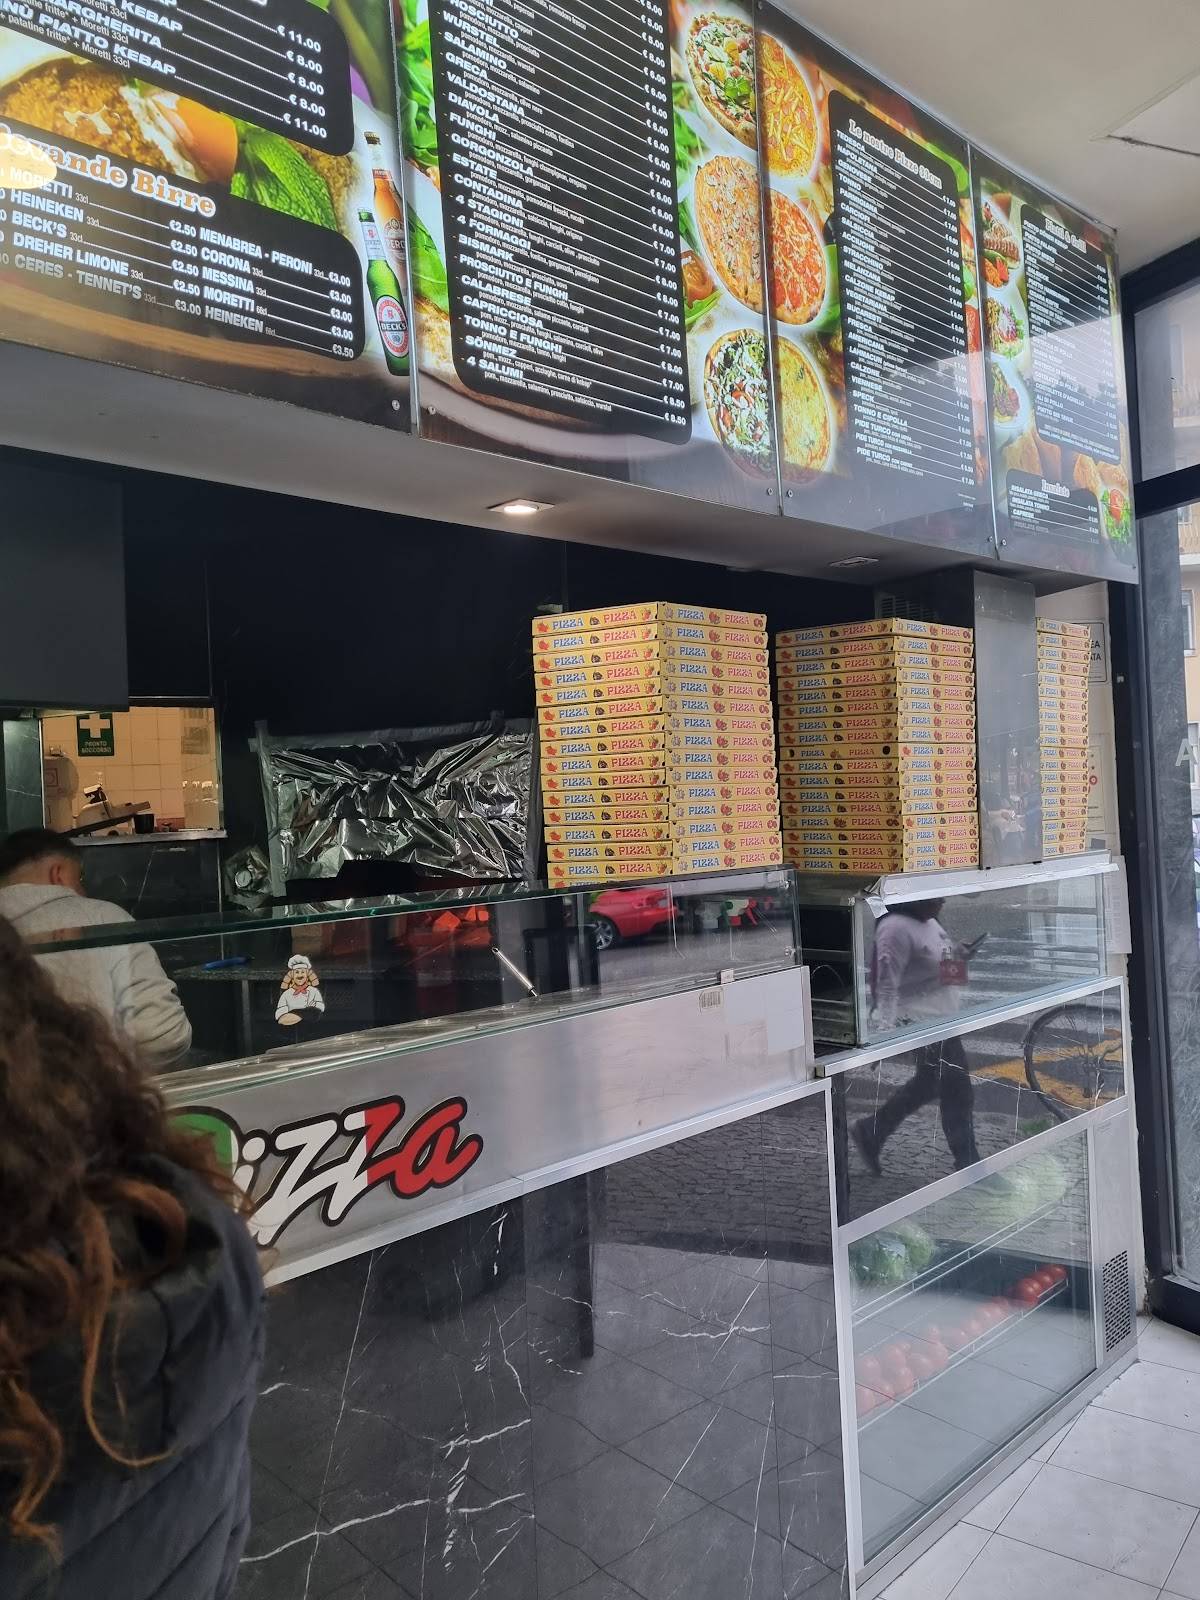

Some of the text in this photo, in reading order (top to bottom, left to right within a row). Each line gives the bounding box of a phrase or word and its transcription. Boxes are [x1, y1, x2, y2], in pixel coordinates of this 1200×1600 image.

[8, 15, 45, 34] patatine
[81, 43, 111, 62] Moretti
[112, 56, 130, 69] 33cl
[80, 18, 109, 37] Moretti
[111, 31, 129, 45] 33cl
[277, 25, 321, 53] € 11.00
[443, 10, 500, 47] WURSTEL
[51, 0, 326, 117] ARGHERITA € 8.00
[121, 0, 324, 95] KEBAP € 8.00
[286, 50, 323, 74] € 8.00
[444, 31, 507, 69] SALAMINO
[38, 13, 109, 49] PIATTO
[114, 43, 176, 75] KEBAP
[283, 113, 291, 125] €
[294, 117, 327, 138] 11.00
[445, 52, 488, 80] GRECA
[447, 71, 525, 117] VALDOSTANA
[448, 92, 500, 123] DIAVOLA
[450, 112, 496, 140] FUNGHI
[451, 133, 534, 176] GORGONZOLA
[453, 153, 497, 180] ESTATE
[895, 147, 918, 175] Pizze
[131, 168, 216, 217] Birre
[454, 174, 523, 209] CONTADINA
[455, 195, 523, 228] 4 STAGIONI
[10, 187, 84, 223] HEINEKEN
[86, 216, 99, 227] 33cl
[170, 239, 198, 258] €2.50
[201, 247, 251, 274] CORONA
[329, 290, 352, 305] €3.00
[75, 192, 89, 205] 33cl
[169, 220, 197, 238] €2.50
[200, 227, 262, 259] MENABREA
[271, 250, 313, 275] PERONI
[328, 271, 351, 287] €3.00
[457, 215, 531, 250] 4 FORMAGGI
[459, 233, 514, 261] BISMARK
[12, 209, 67, 238] BECK'S
[69, 231, 83, 243] 33cl
[172, 259, 199, 277] €2.50
[202, 267, 254, 294] MESSINA
[330, 308, 353, 323] €3.00
[460, 253, 568, 300] PROSCIUTTO E FUNGHI
[13, 232, 73, 260] DREHER
[76, 249, 129, 276] LIMONE
[131, 269, 143, 280] 33cl
[173, 279, 200, 297] €2.50
[203, 286, 255, 312] MORETTI
[331, 325, 353, 341] €3.00
[461, 275, 531, 306] CALABRESE
[15, 253, 64, 279] CERES
[76, 268, 142, 300] TENNET'S
[175, 299, 201, 316] €3.00
[205, 305, 264, 333] HEINEKEN
[332, 344, 354, 359] €3.50
[462, 295, 544, 329] CAPRICCIOSA
[464, 315, 507, 336] TONNO
[509, 330, 517, 340] E
[520, 333, 562, 354] FUNGHI
[668, 381, 684, 392] 7.00
[467, 356, 476, 367] 4
[479, 359, 523, 379] SALUMI
[670, 415, 686, 426] 8.50
[669, 398, 686, 409] 8.50
[552, 607, 749, 630] PIZZA PIZZA PIZZA PIZZA
[795, 623, 961, 642] PIZZA PIZZA PIZZA PIZZA
[568, 853, 766, 875] PIZZA PIZZA PIZZA PIZZA
